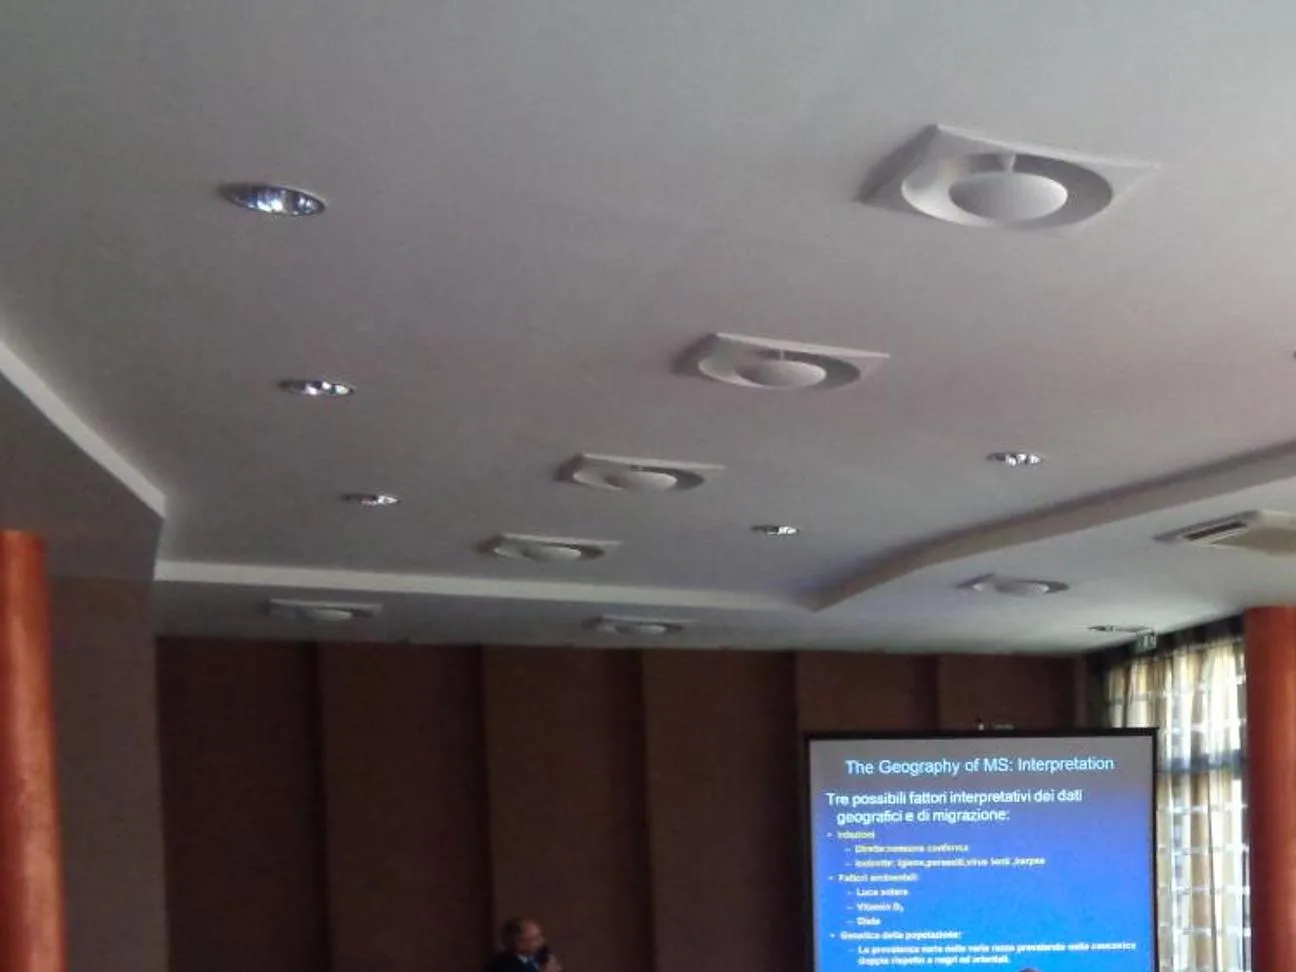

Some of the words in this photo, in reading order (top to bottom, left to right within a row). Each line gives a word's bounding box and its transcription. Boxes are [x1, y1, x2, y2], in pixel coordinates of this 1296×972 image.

[846, 760, 873, 774] The
[879, 758, 959, 776] Geography
[965, 758, 980, 772] of
[984, 757, 1013, 772] MS:
[1018, 756, 1114, 773] Interpretation
[826, 793, 849, 806] Tre
[852, 791, 906, 807] possibili
[909, 791, 947, 805] fattori
[949, 790, 1031, 806] interpretativi
[1034, 789, 1055, 803] dei
[1057, 789, 1082, 802] dati
[837, 810, 901, 825] geografici
[904, 812, 913, 822] e
[917, 810, 930, 822] di
[932, 809, 1010, 824] migrazione:
